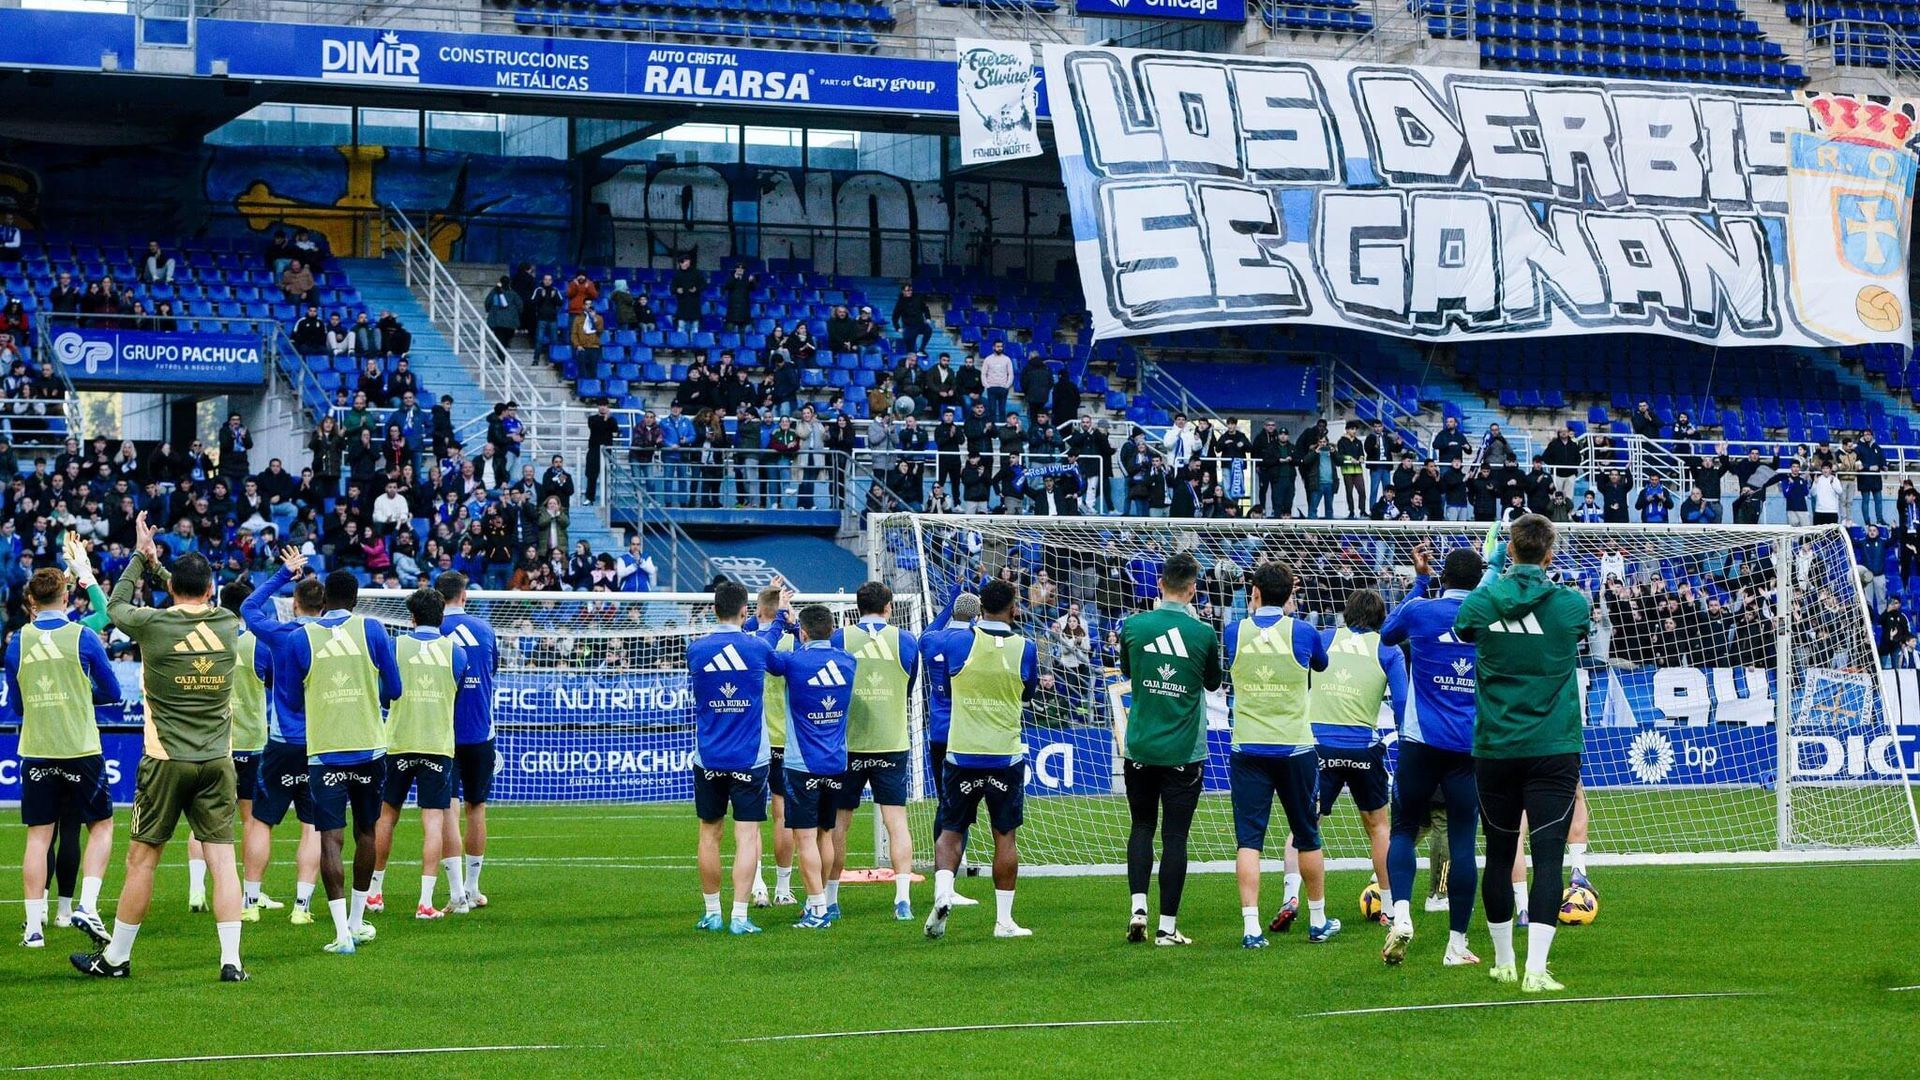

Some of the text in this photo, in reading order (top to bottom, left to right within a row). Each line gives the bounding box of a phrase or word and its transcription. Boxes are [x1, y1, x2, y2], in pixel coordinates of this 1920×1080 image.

[439, 47, 589, 70] CONSTRUCCIONES
[648, 50, 739, 66] AUTO CRISTAL
[496, 70, 589, 91] METÁLICAS
[644, 65, 810, 100] RALARSA
[820, 78, 840, 86] PART
[853, 75, 888, 92] Cary
[889, 77, 936, 94] group
[1066, 53, 1346, 185] LOS
[972, 143, 1032, 158] FONDO NORTE
[1098, 178, 1313, 329] SE
[1310, 188, 1784, 337] GANAN
[123, 345, 179, 361] GRUPO
[182, 346, 259, 364] PACHUCA
[174, 675, 226, 684] CAJA RURAL
[1143, 680, 1188, 694] CAJA RURAL
[1433, 676, 1455, 685] CAJA
[709, 699, 751, 708] CAJA RURAL
[807, 712, 824, 720] CAJA
[520, 751, 602, 774] GRUPO
[1684, 739, 1718, 774] bp
